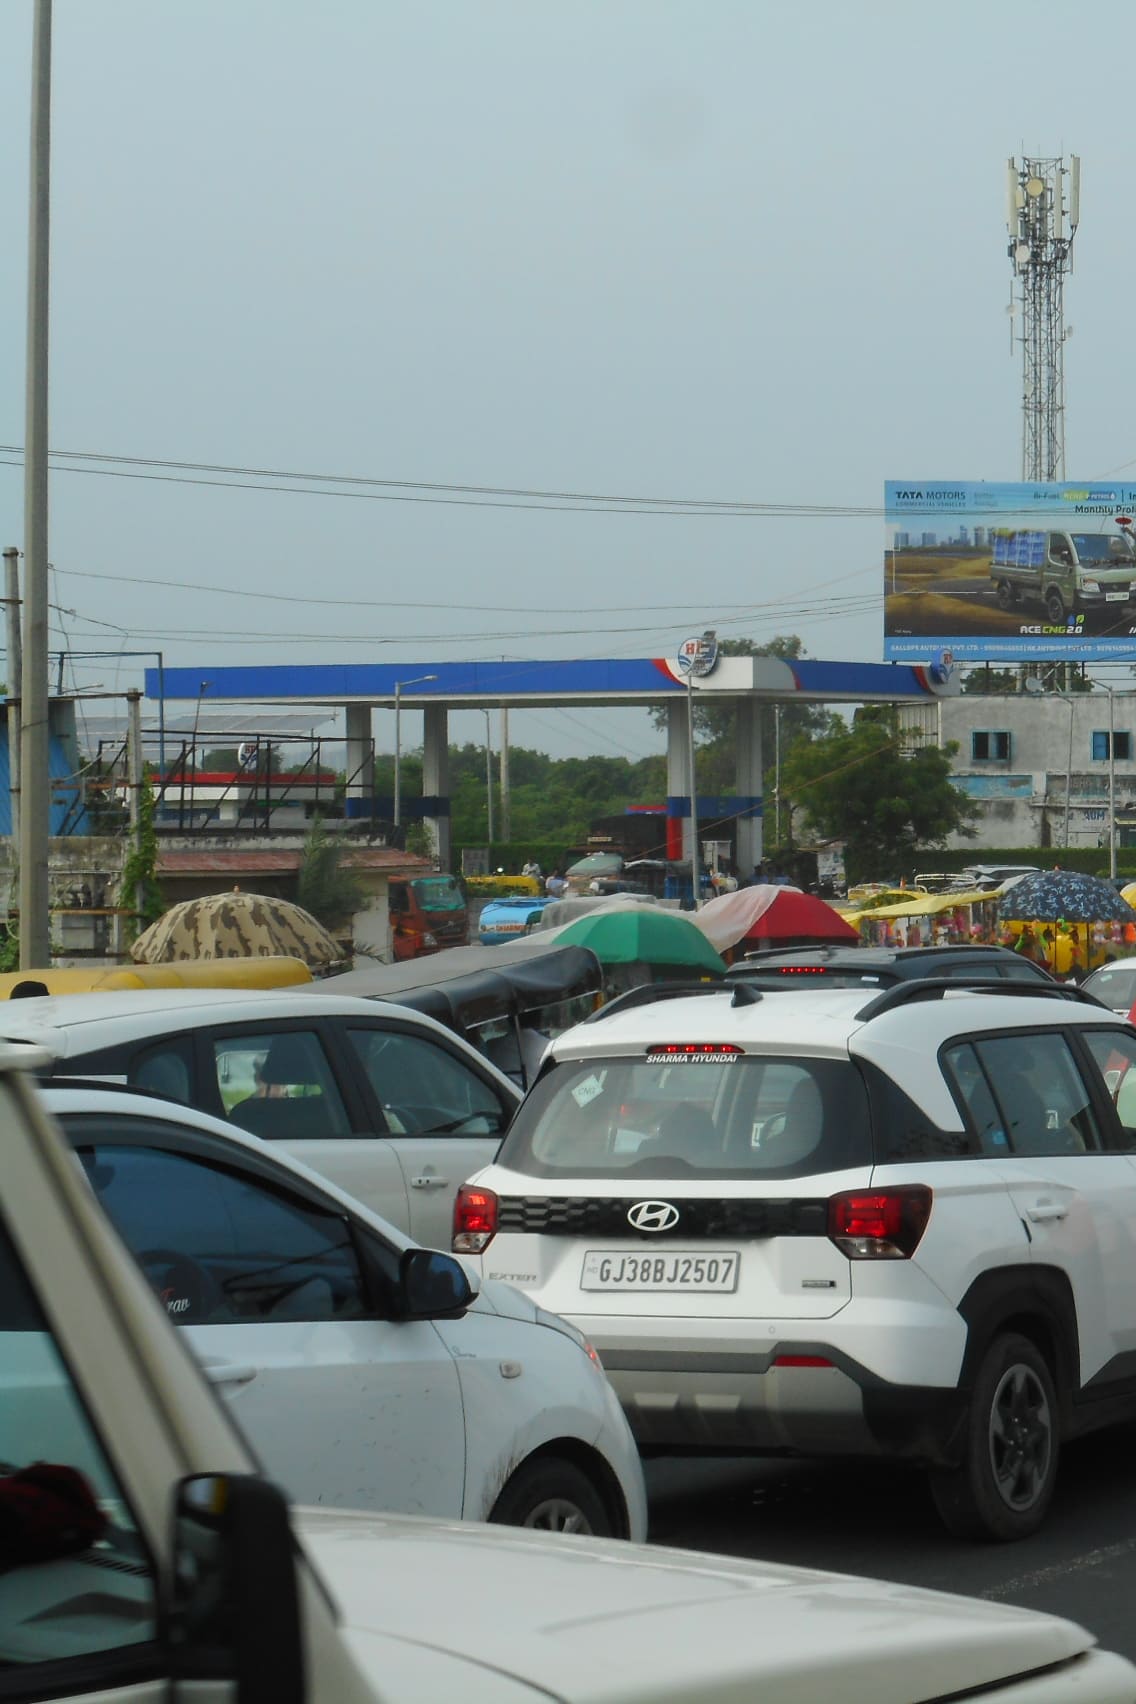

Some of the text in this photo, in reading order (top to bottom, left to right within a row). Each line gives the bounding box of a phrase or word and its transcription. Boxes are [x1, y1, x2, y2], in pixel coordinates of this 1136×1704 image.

[895, 491, 923, 500] TATA
[926, 491, 966, 500] MOTORS
[1075, 504, 1114, 516] Monthly
[1020, 626, 1083, 634] ACE CNG 2.0
[646, 1054, 738, 1063] SHARMA HYUNDAI
[600, 1257, 734, 1284] GJ38BJ2507
